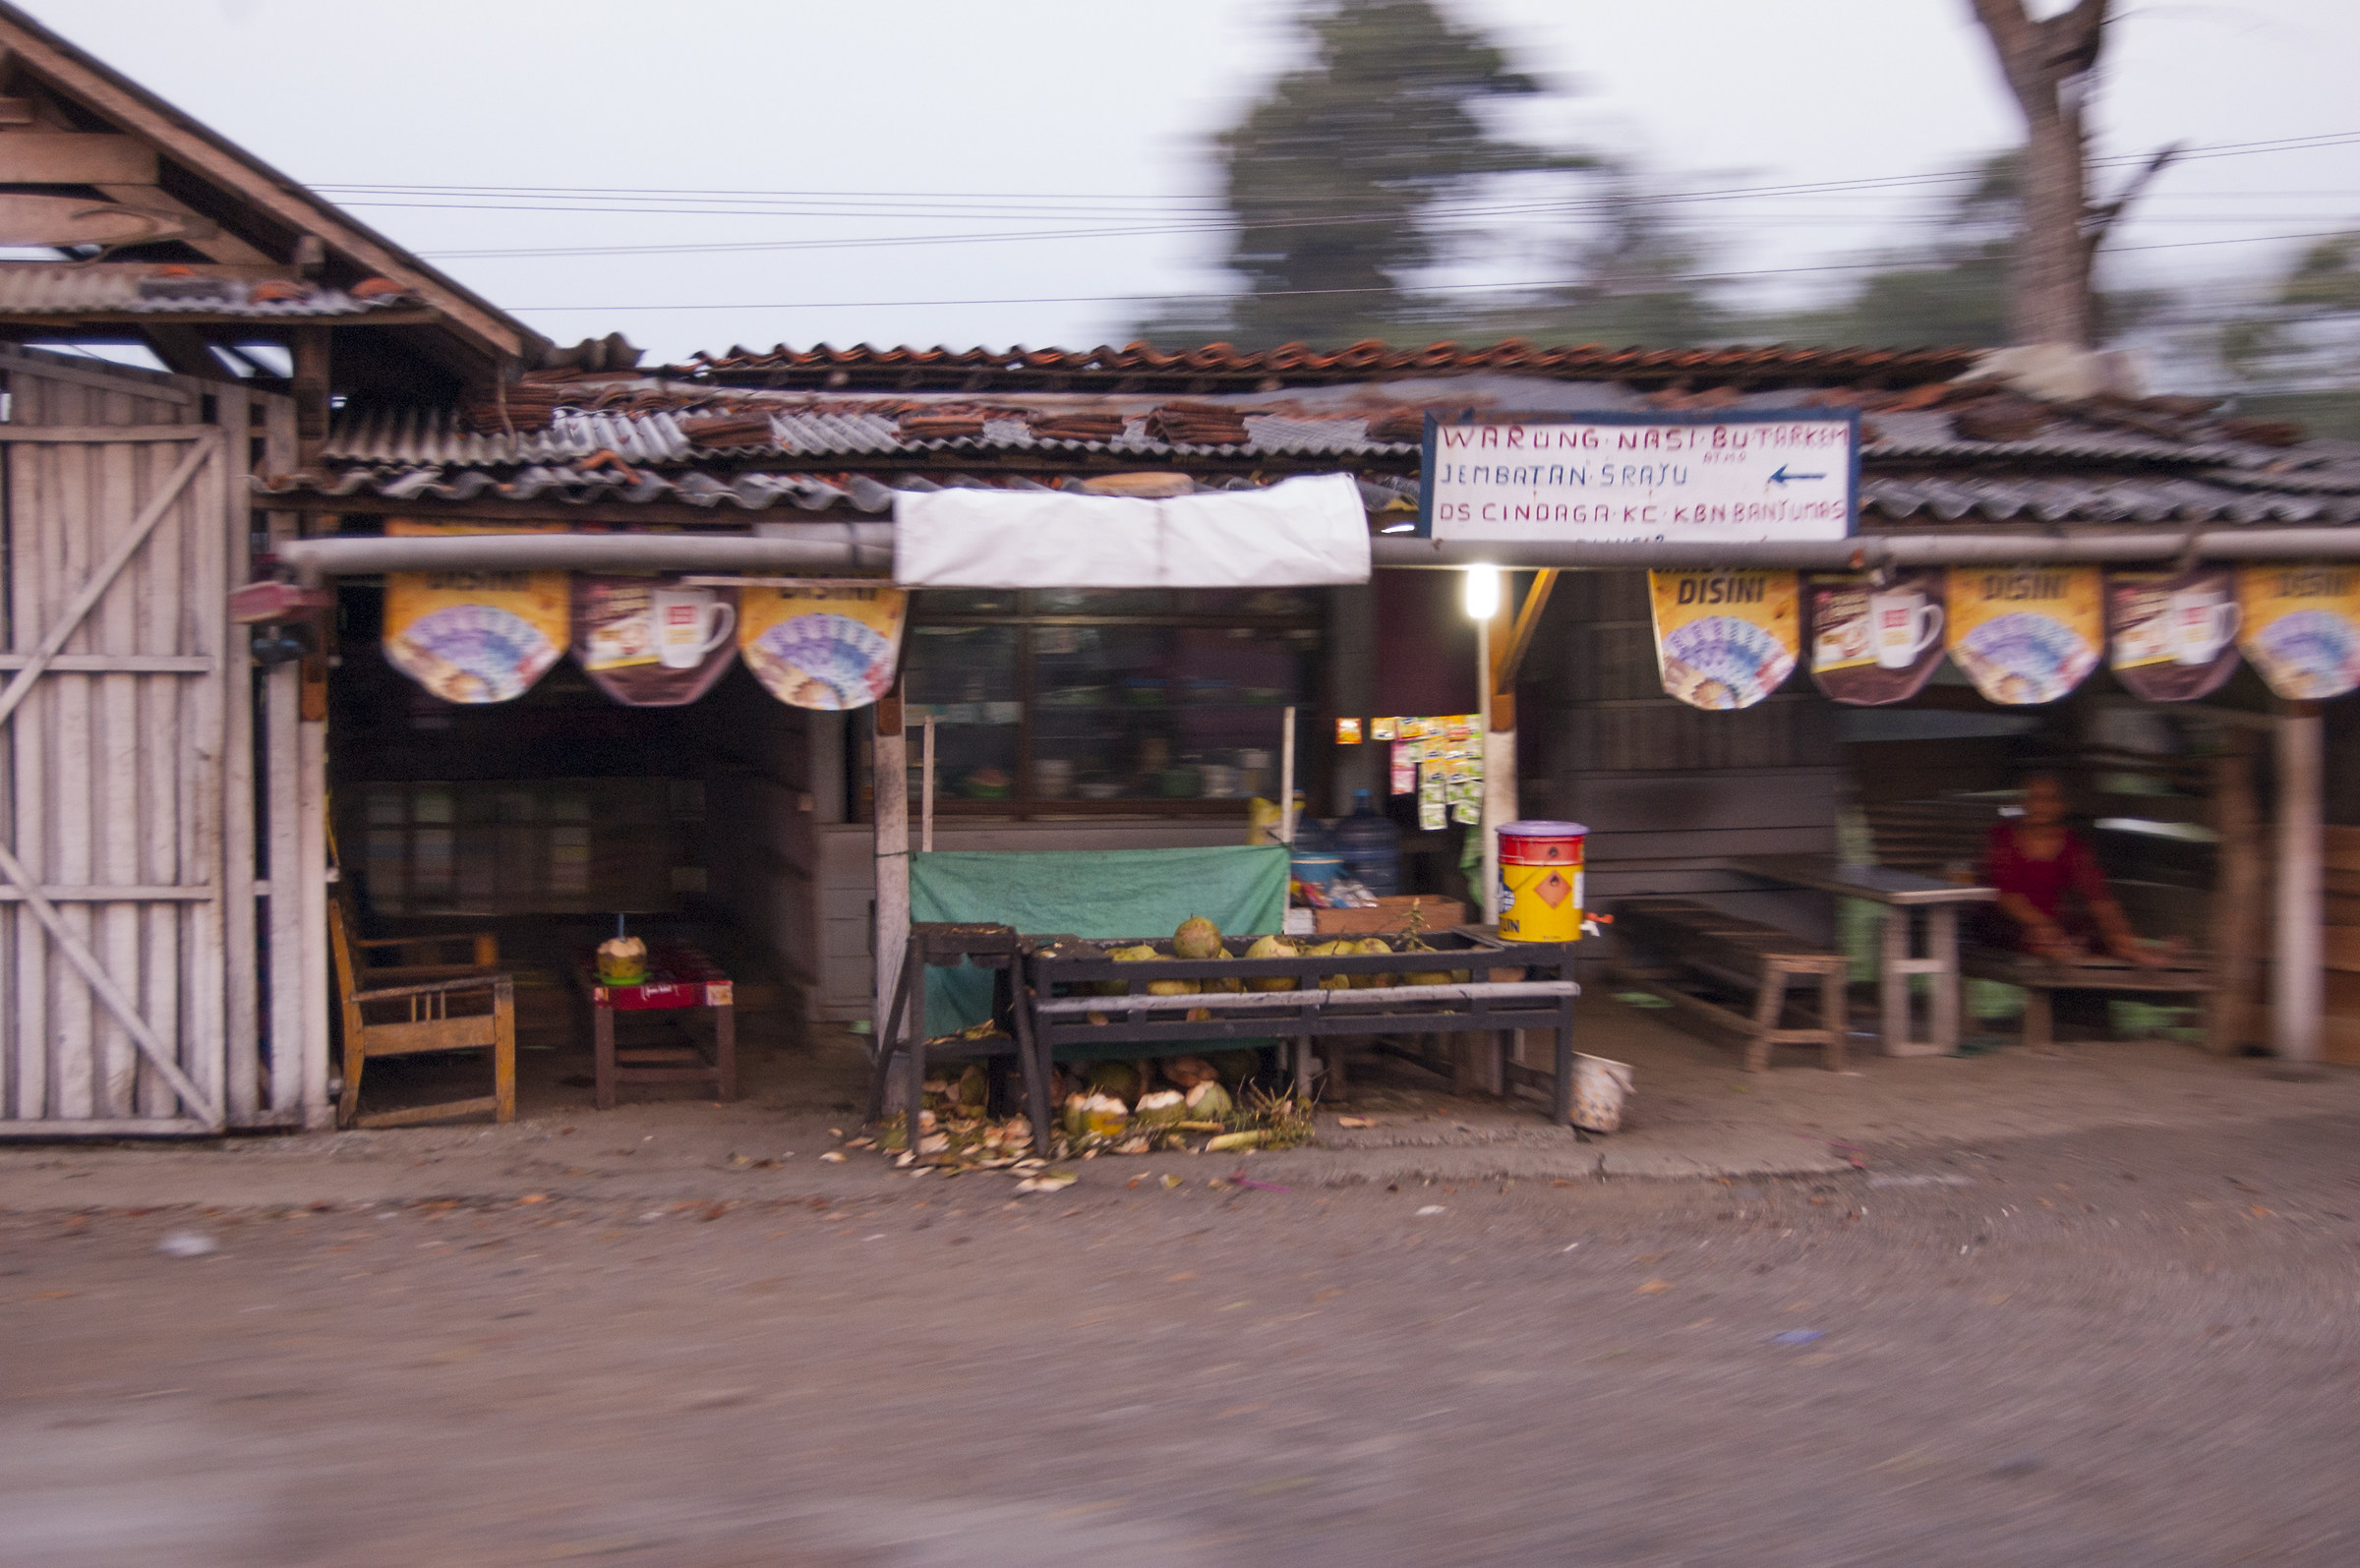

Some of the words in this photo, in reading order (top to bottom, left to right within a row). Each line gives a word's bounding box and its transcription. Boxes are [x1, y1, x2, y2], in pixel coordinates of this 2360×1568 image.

[1443, 425, 1599, 449] WARUNG
[1619, 427, 1695, 450] NASI
[1712, 425, 1748, 449] BU
[1441, 463, 1586, 486] JEMBATAN
[1441, 502, 1471, 522] DS
[1482, 502, 1610, 523] CINDAGA
[1623, 505, 1658, 523] KC
[1678, 577, 1766, 605] DISINI
